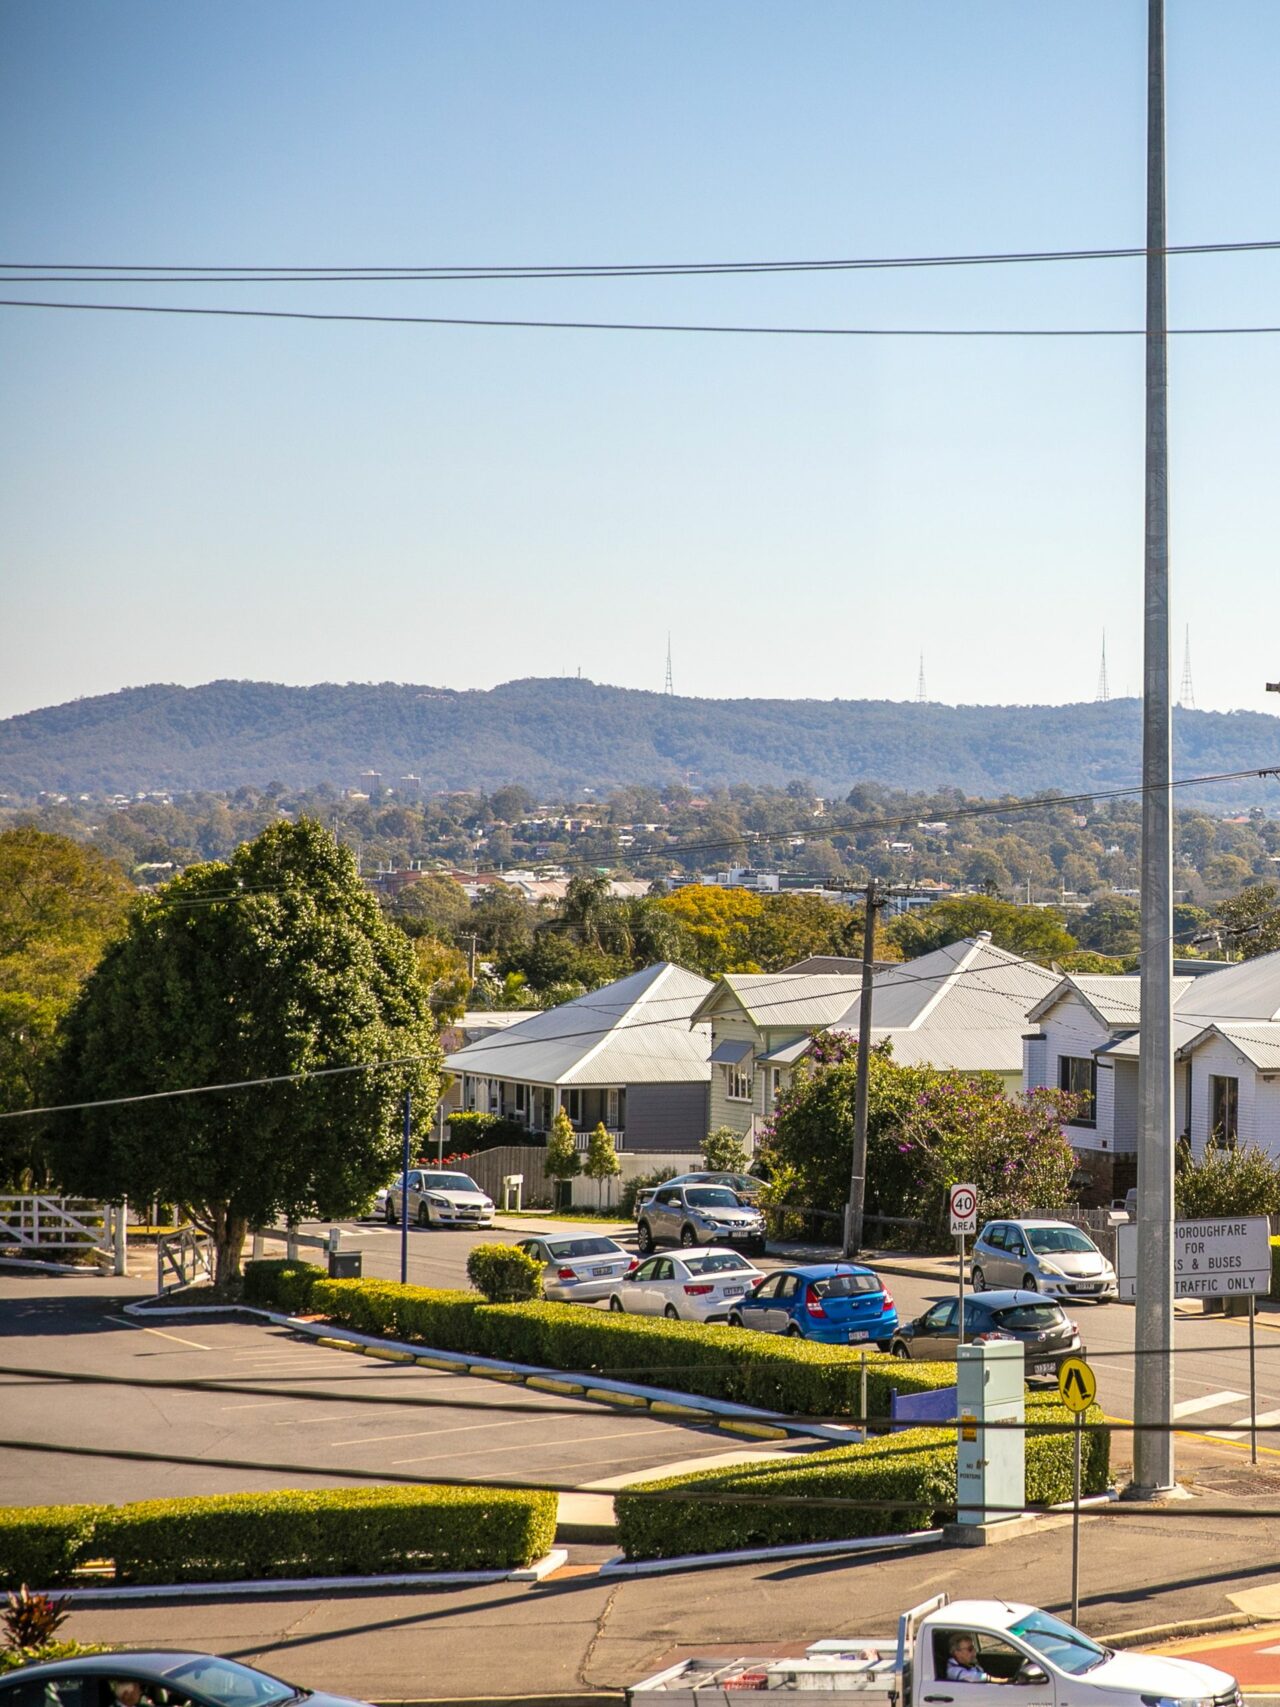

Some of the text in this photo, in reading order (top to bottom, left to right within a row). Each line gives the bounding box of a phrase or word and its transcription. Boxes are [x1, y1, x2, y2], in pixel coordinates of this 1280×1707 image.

[956, 1197, 972, 1210] 40
[952, 1222, 975, 1231] AREA
[1174, 1224, 1247, 1239] HOROUGHFARE
[1185, 1242, 1205, 1254] FOR
[1192, 1258, 1199, 1270] &
[1208, 1256, 1242, 1269] BUSES
[1175, 1276, 1255, 1293] TRAFFIC ONLY
